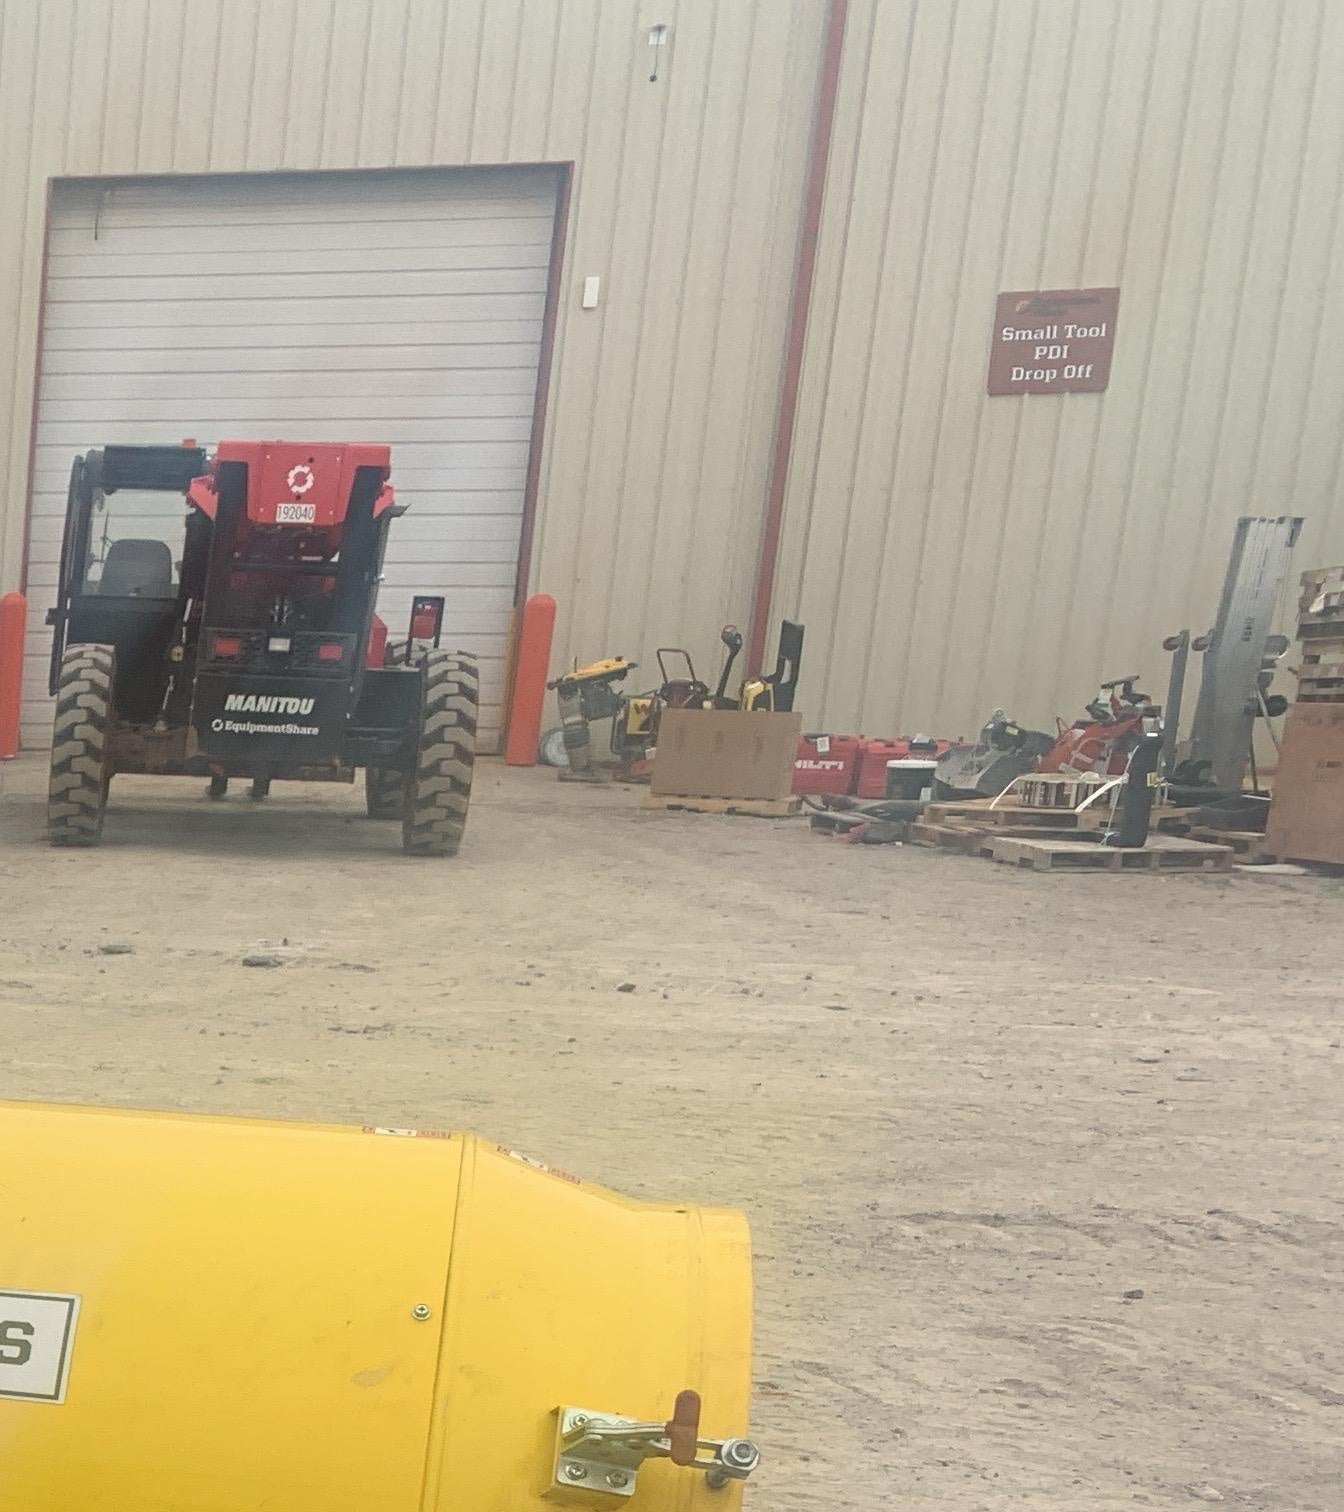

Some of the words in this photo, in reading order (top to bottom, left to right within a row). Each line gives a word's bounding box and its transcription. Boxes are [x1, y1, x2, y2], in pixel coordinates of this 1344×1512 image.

[1002, 325, 1057, 341] Small
[1064, 323, 1107, 339] Tool
[1034, 344, 1070, 360] PDI
[1011, 366, 1057, 382] Drop
[1063, 364, 1094, 379] Off
[278, 505, 314, 520] 192040
[224, 694, 315, 715] MANITOU
[224, 720, 319, 735] EquipmentShare
